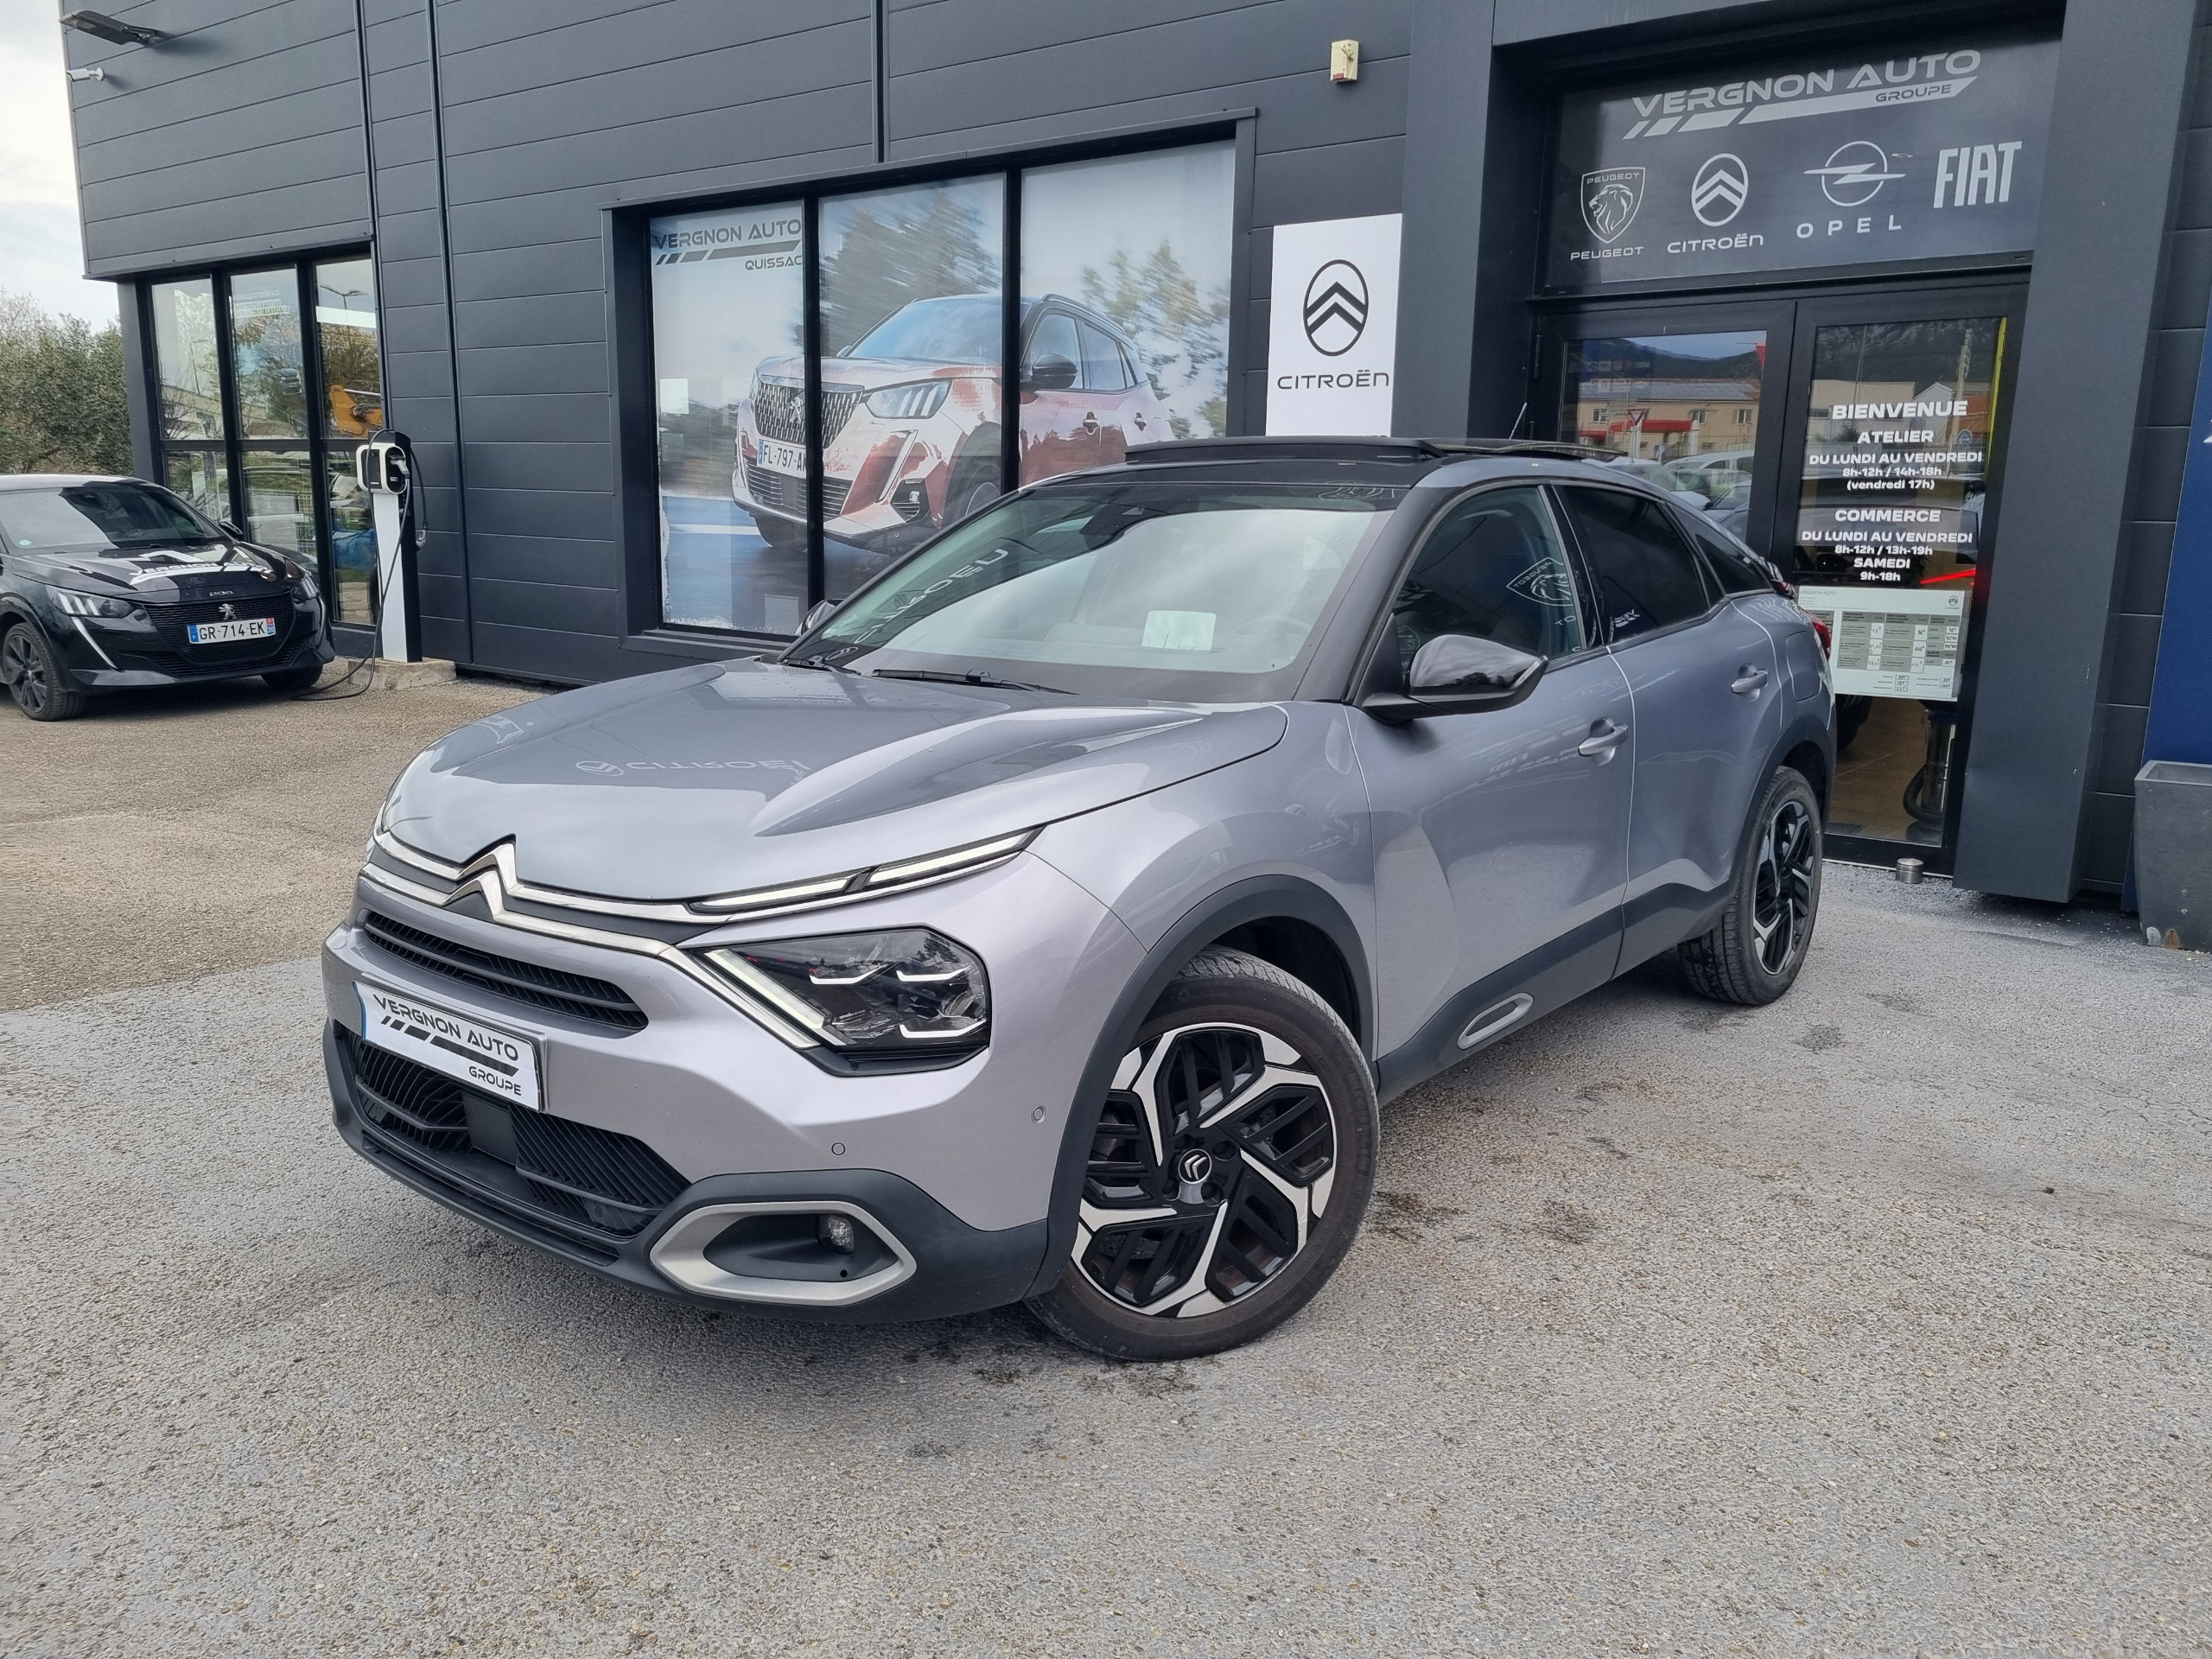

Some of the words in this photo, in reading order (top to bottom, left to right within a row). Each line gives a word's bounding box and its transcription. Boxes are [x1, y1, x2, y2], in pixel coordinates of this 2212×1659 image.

[1631, 70, 1834, 117] VERGNON
[1846, 49, 1981, 89] AUTO
[1875, 84, 1953, 105] GROUPE
[1586, 172, 1640, 186] PEUGEOT
[1933, 141, 2022, 209] FIAT
[654, 226, 742, 250] VERGNON
[748, 219, 802, 240] AUTO
[1796, 218, 1903, 239] OPEL
[1570, 246, 1644, 261] PEUGEOT
[745, 255, 803, 270] QUISSAC
[1832, 400, 1968, 420] BIENVENUE
[1857, 429, 1935, 444] ATELIER
[1809, 454, 1830, 465] DU
[1832, 453, 1876, 464] LUNDI
[1879, 453, 1901, 463] AU
[1904, 451, 1983, 463] VENDREDI
[1842, 467, 1884, 478] 8h-12h
[1894, 466, 1942, 477] 14h-18h
[1847, 480, 1906, 491] (vendredi
[1908, 480, 1935, 491] 17h)
[1834, 509, 1942, 523] COMMERCE
[1802, 531, 1822, 542] DU
[1824, 531, 1868, 543] LUNDI
[1872, 531, 1893, 543] AU
[1896, 531, 1973, 543] VENDREDI
[1834, 544, 1875, 556] 8h-12h
[1885, 545, 1934, 556] 13h-19h
[1853, 557, 1911, 569] SAMEDI
[1859, 571, 1901, 582] 9h-18h
[199, 621, 266, 640] GR-714-EK
[372, 994, 462, 1039] VERGNON
[467, 1029, 519, 1061] AUTO
[468, 1065, 522, 1096] GROUPE
